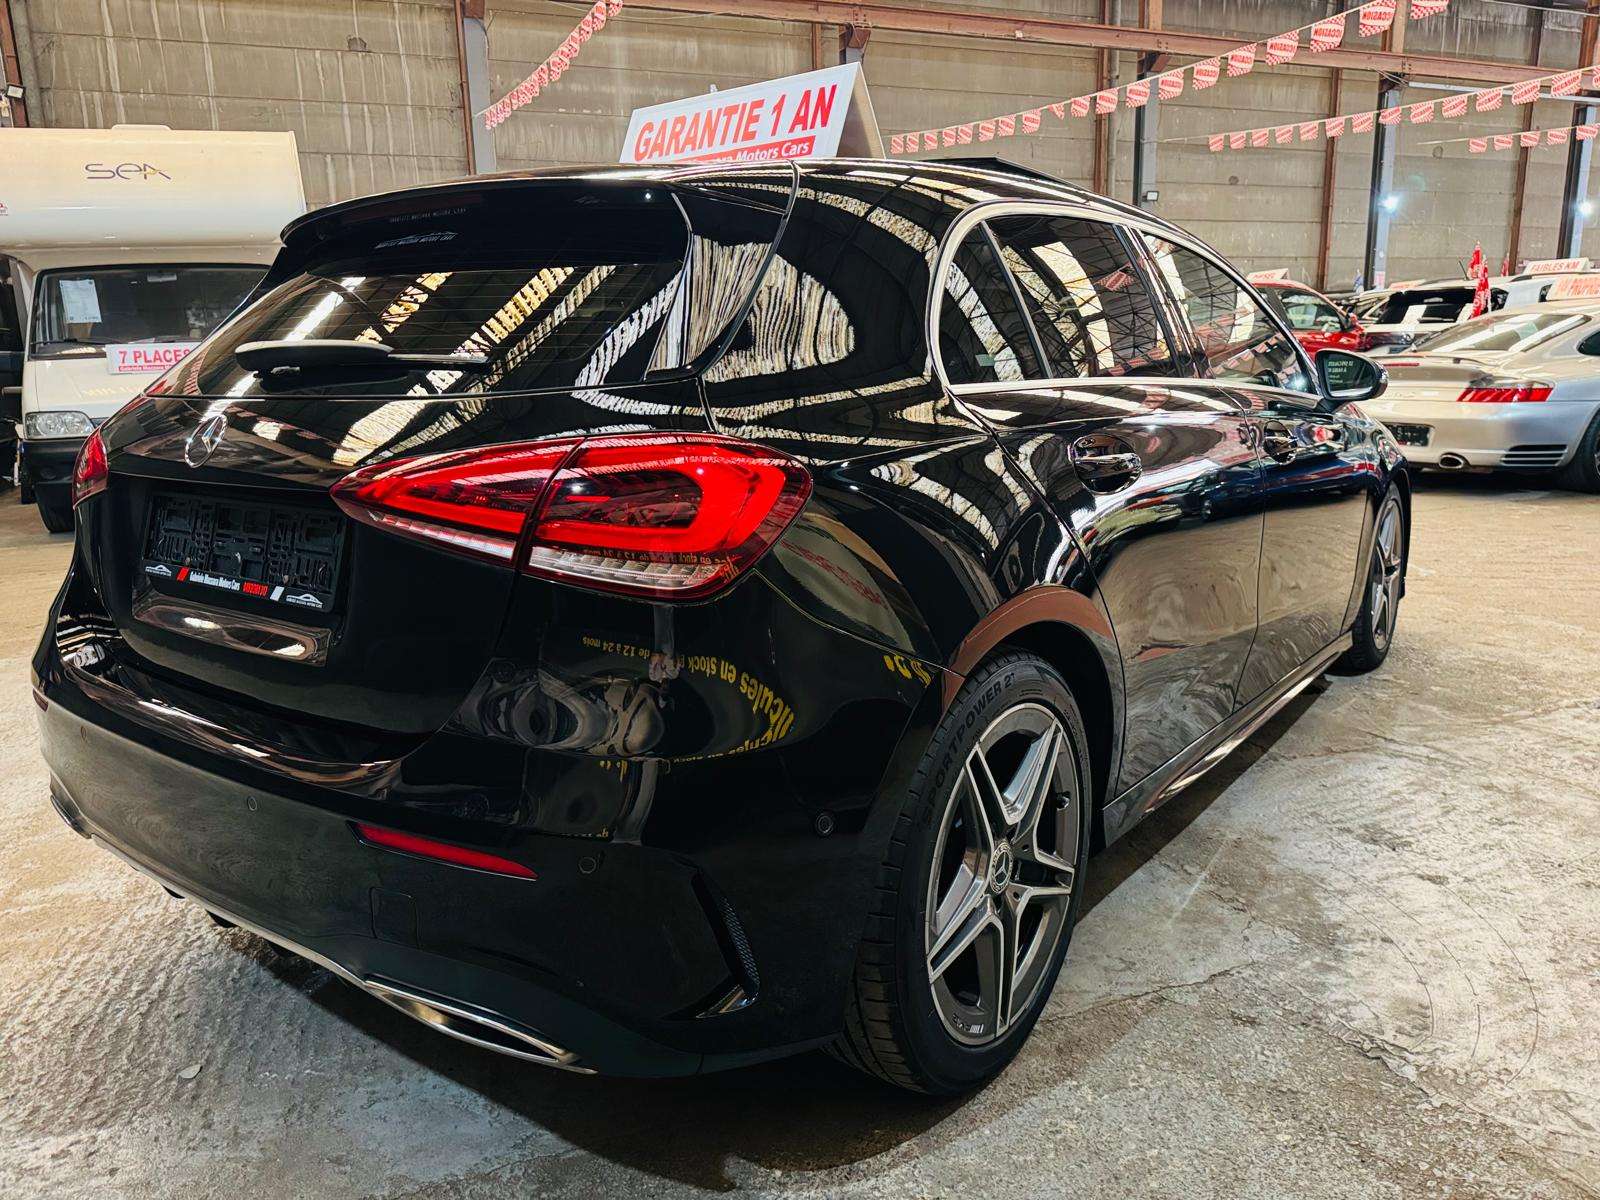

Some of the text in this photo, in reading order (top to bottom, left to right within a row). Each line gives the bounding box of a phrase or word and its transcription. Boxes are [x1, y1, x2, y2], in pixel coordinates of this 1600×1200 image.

[633, 85, 838, 162] GARANTIE 1 AN
[736, 144, 779, 161] Motors
[781, 141, 810, 157] Cars
[118, 350, 127, 364] 7
